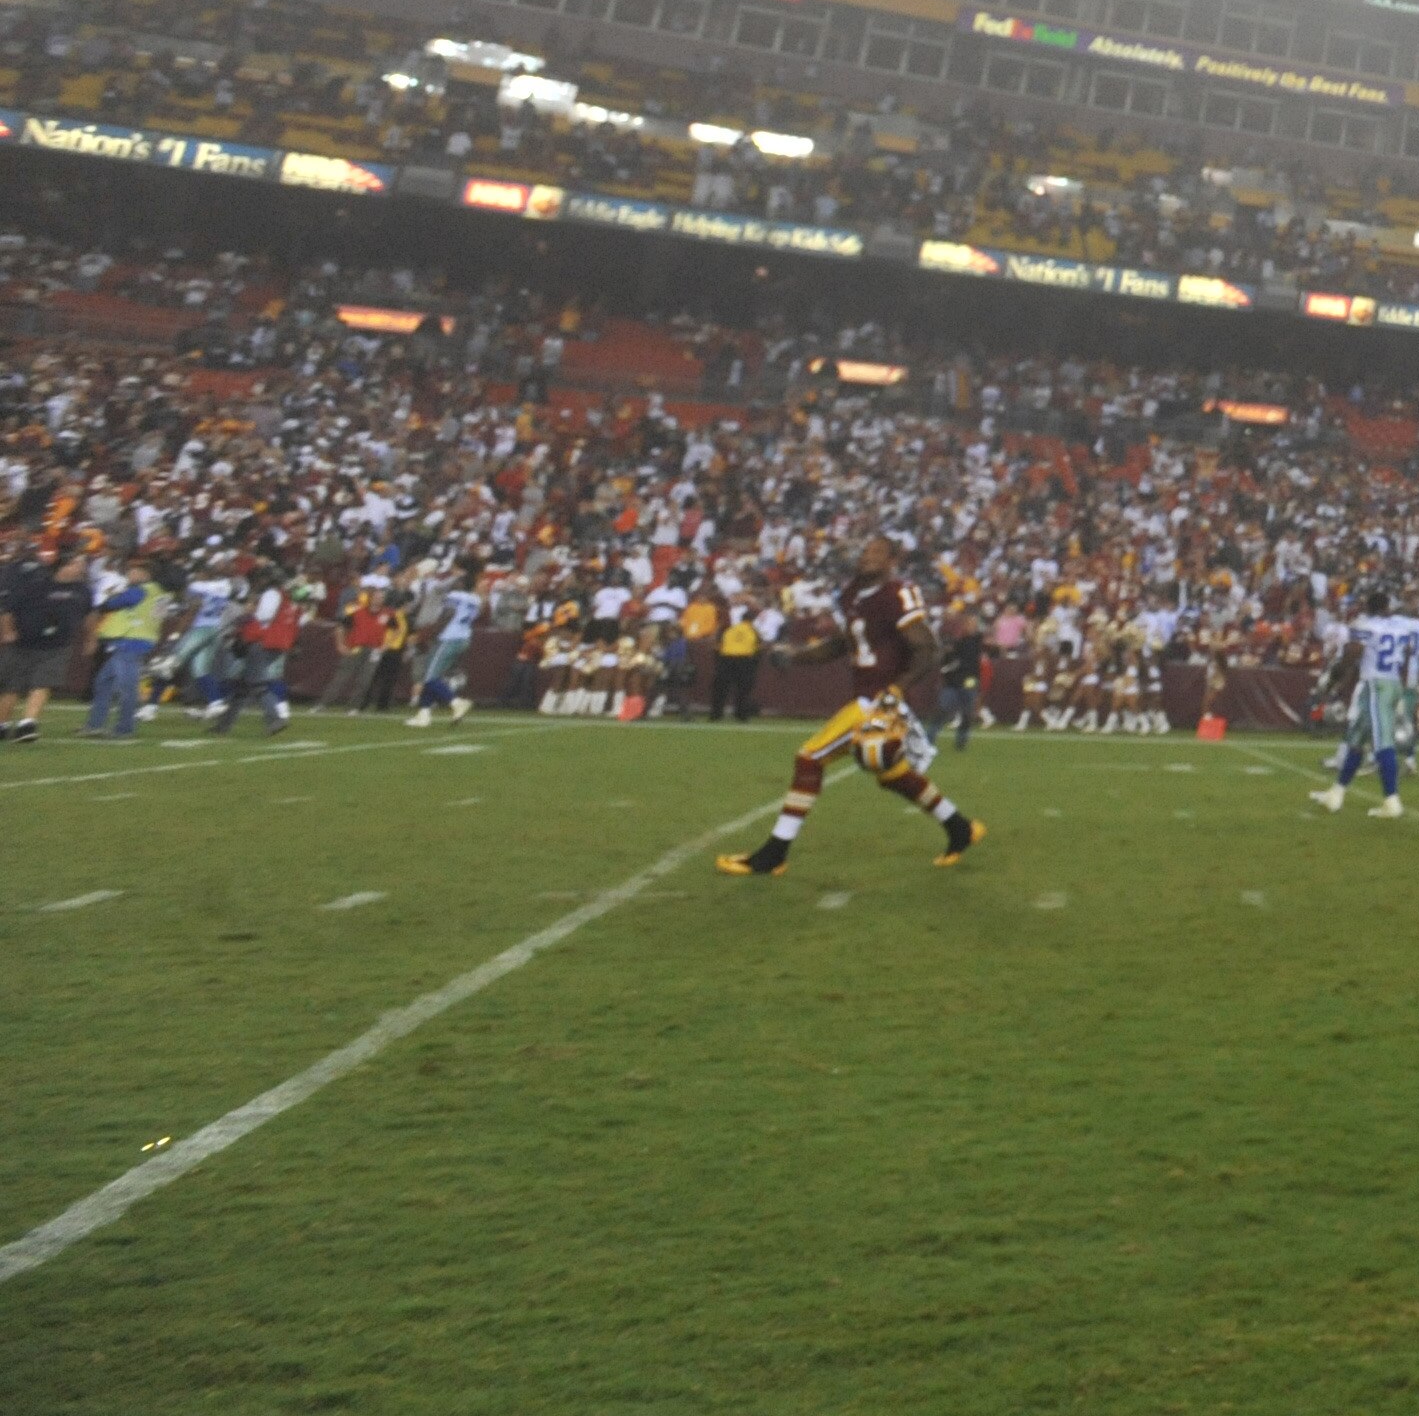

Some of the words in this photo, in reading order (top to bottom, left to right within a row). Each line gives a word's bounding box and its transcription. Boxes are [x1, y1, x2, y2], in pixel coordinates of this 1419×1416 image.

[20, 117, 152, 162] Nation's
[193, 142, 267, 177] Fans
[1004, 252, 1090, 287] Nation's
[1119, 269, 1170, 298] Fans
